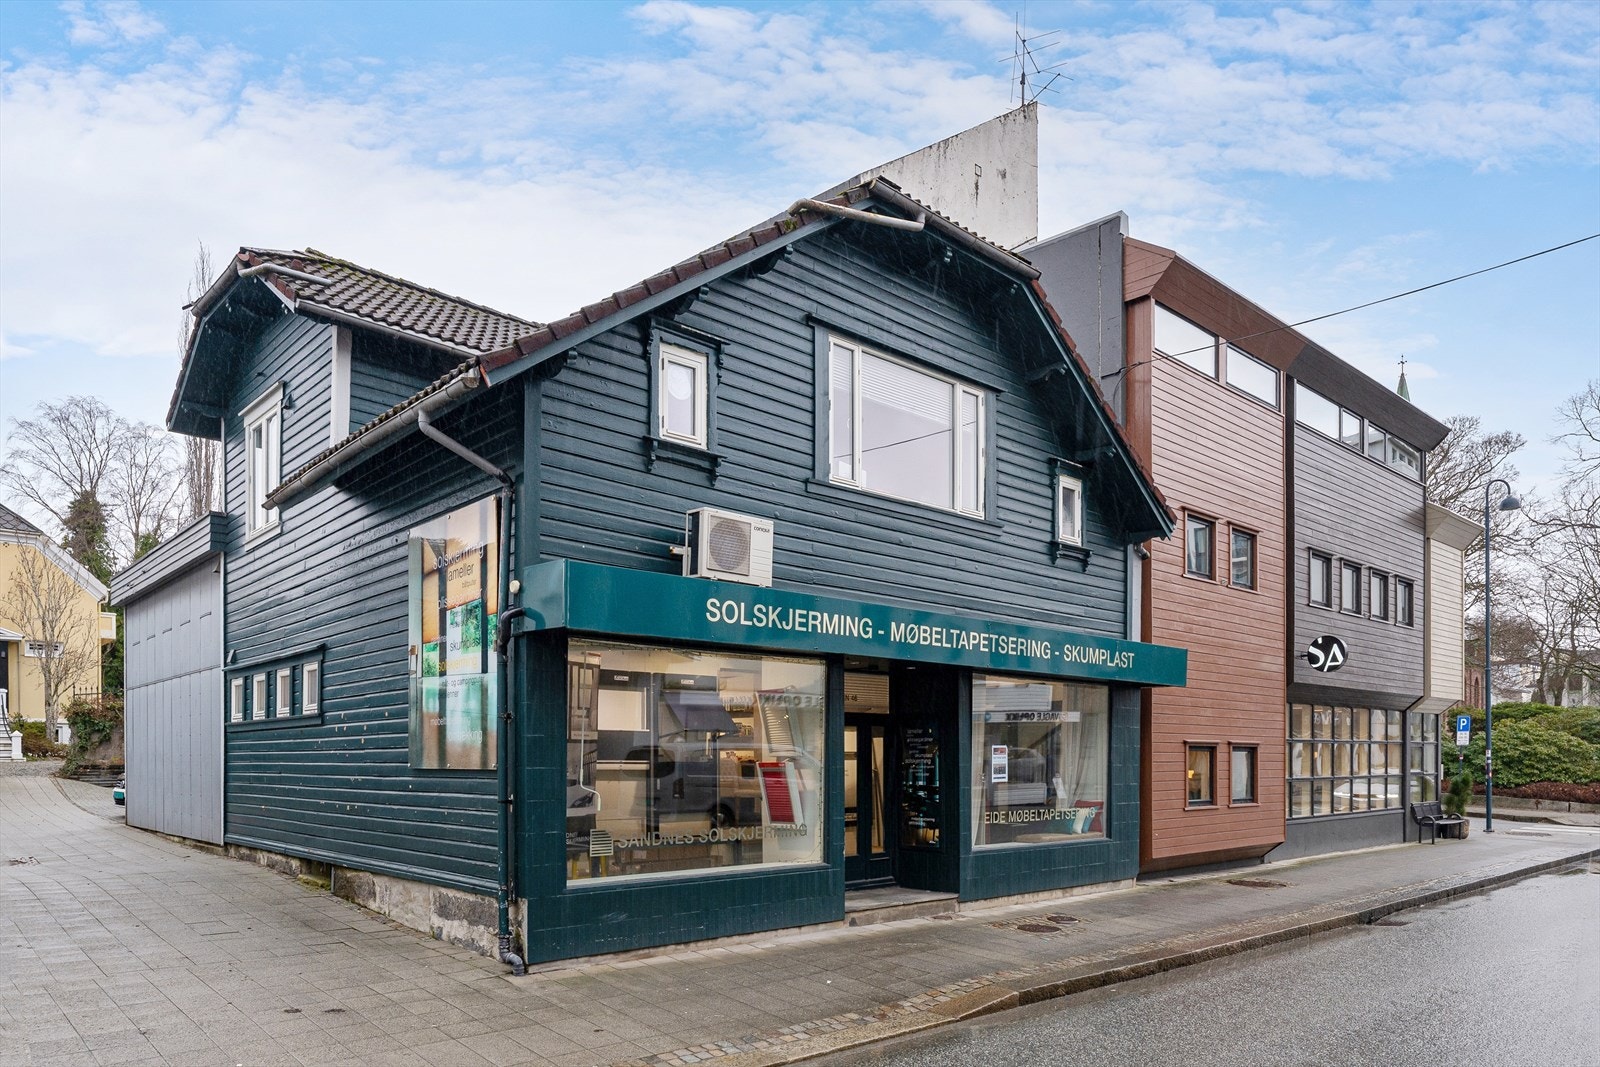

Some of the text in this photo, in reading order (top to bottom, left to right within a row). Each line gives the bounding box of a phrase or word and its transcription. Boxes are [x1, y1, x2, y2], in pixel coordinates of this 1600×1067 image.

[446, 562, 475, 582] ameller
[705, 598, 873, 639] SOLSKJERMING
[890, 621, 1051, 659] MØBELTAPETSERING
[1063, 644, 1135, 668] SKUMPLAST
[984, 811, 1006, 824] EIDE
[617, 823, 808, 848] SANDNES SOLSKJERMING
